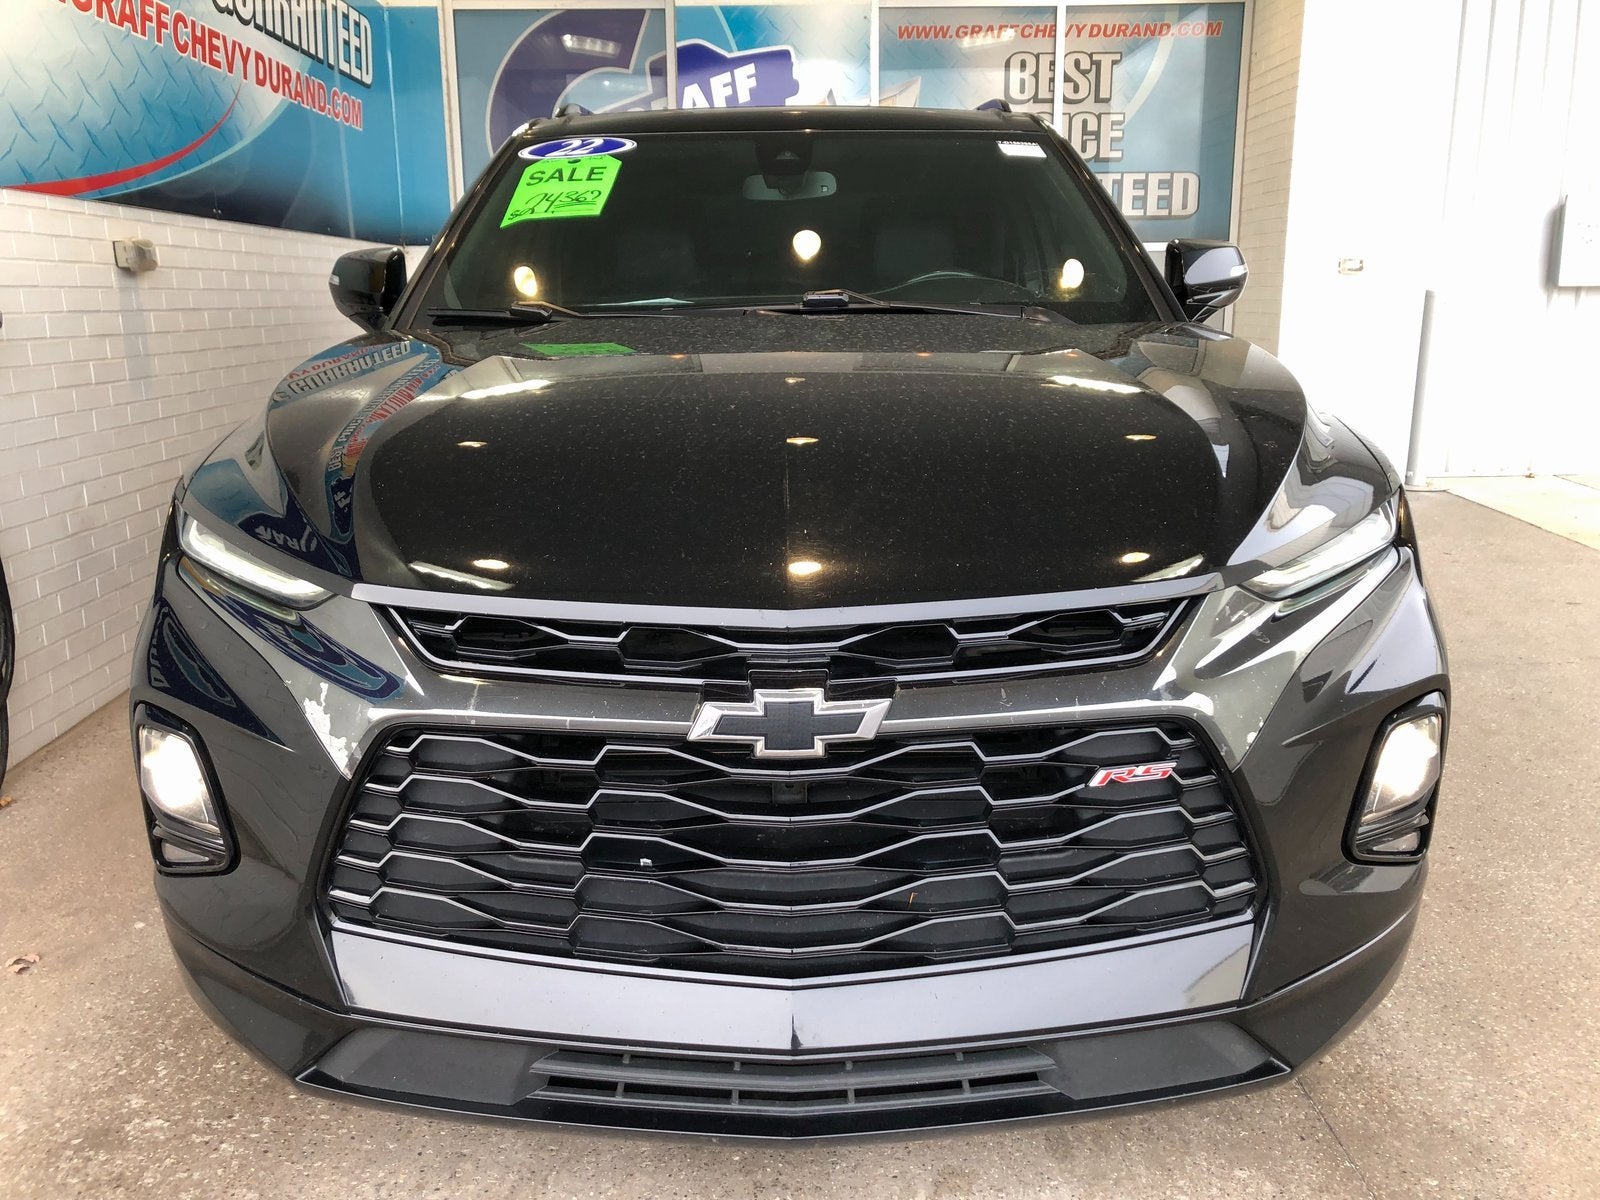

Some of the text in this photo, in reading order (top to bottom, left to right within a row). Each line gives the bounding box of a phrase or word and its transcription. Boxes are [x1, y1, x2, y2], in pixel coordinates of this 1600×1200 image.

[1004, 51, 1122, 104] BEST
[545, 138, 603, 157] 22
[526, 166, 607, 186] SALE
[1087, 761, 1178, 787] RS
